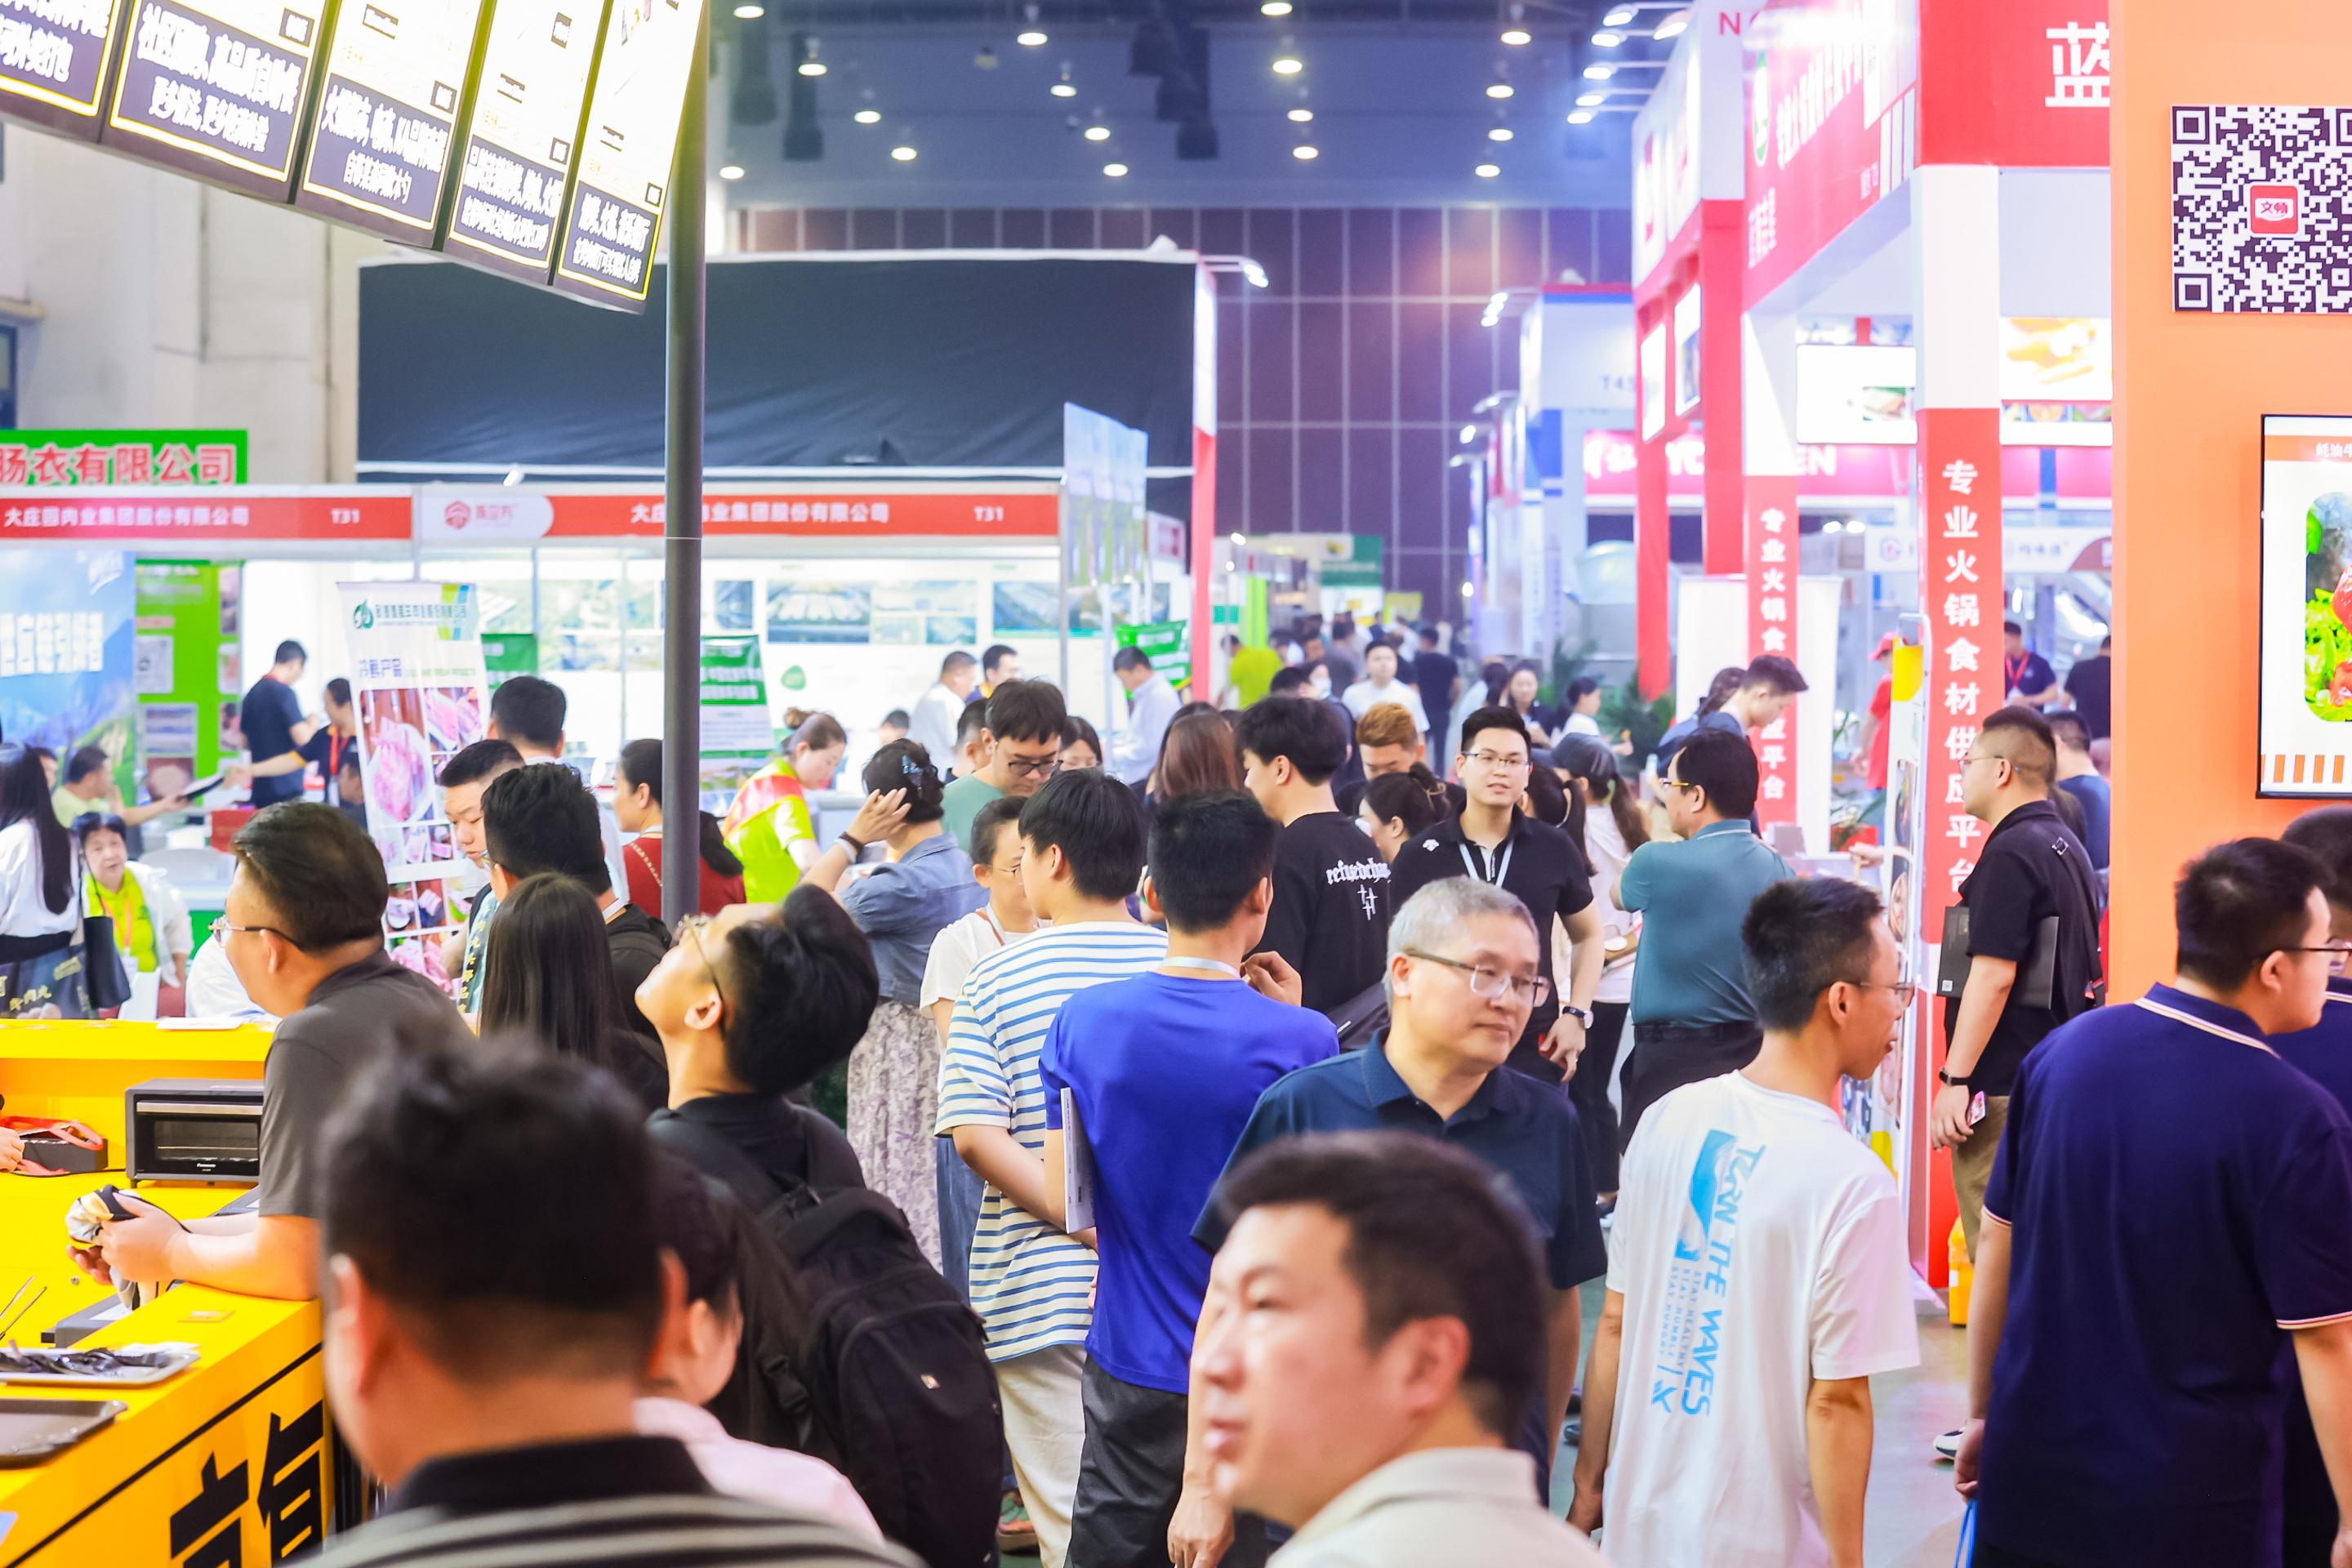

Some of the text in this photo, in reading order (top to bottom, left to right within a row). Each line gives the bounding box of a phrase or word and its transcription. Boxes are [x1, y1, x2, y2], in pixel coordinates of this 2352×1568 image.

[331, 509, 360, 524] T31
[973, 506, 1004, 522] T31
[1704, 1237, 1735, 1298] THE
[1681, 1309, 1722, 1417] WAVES
